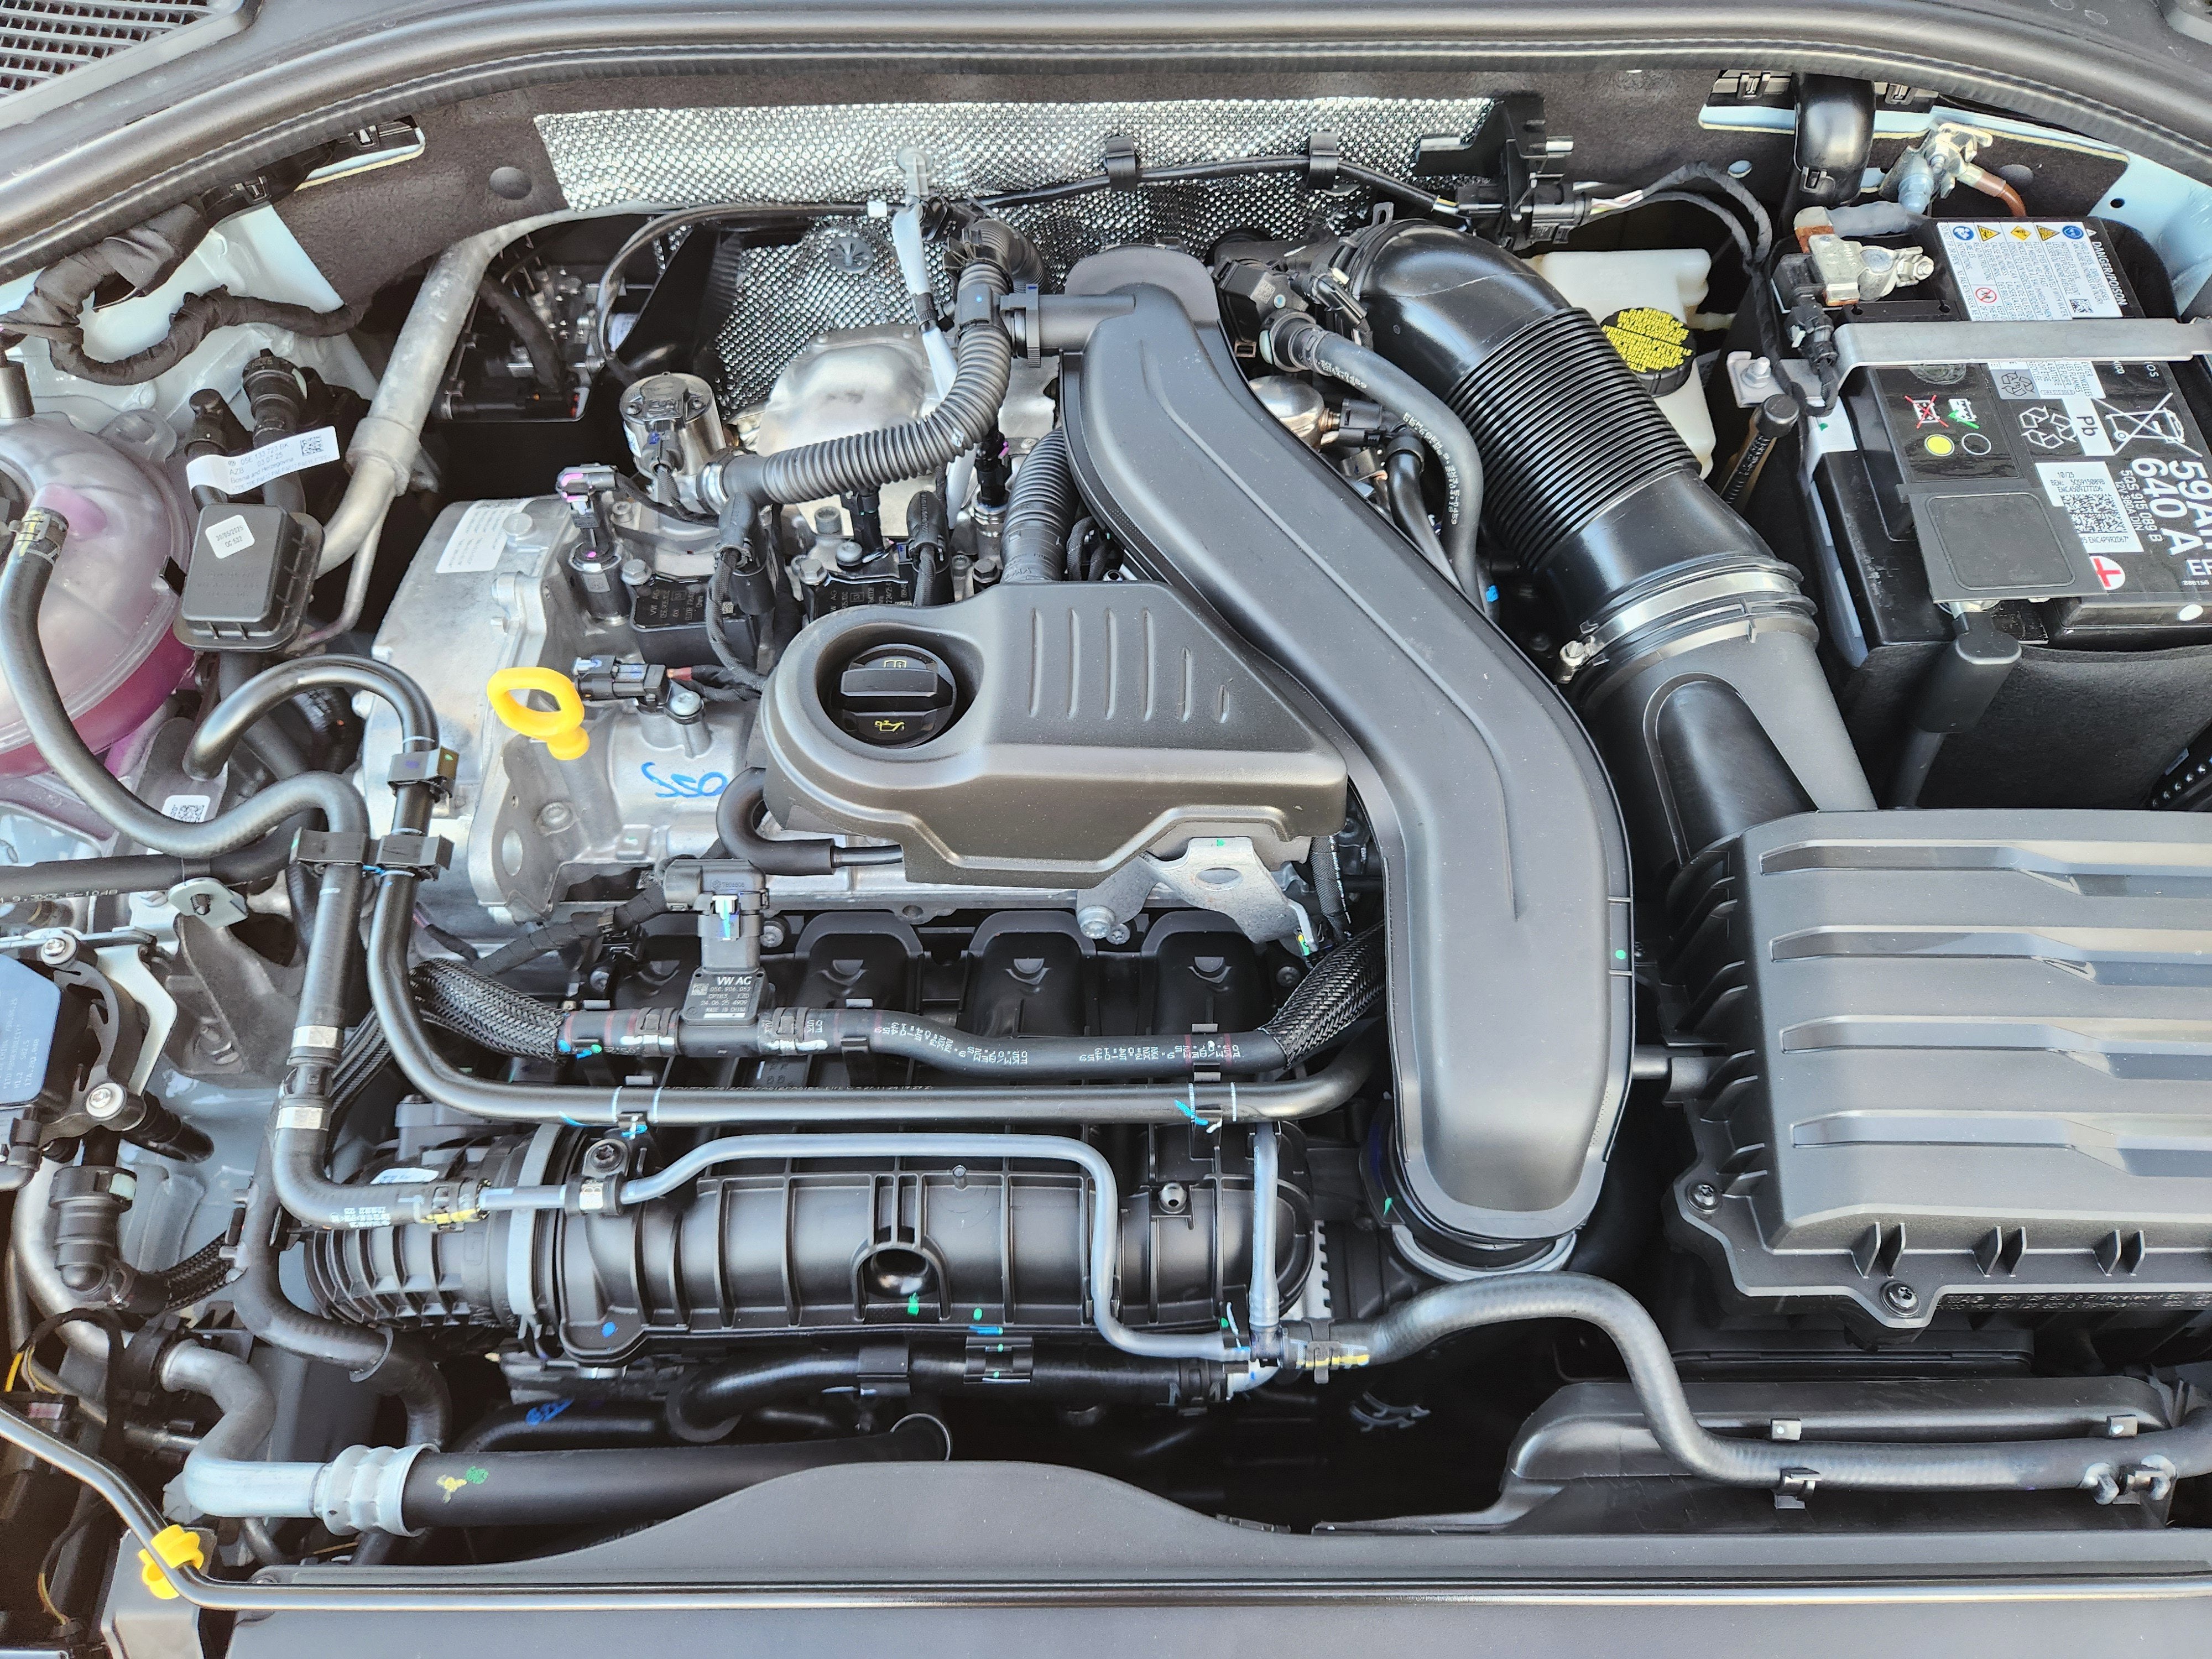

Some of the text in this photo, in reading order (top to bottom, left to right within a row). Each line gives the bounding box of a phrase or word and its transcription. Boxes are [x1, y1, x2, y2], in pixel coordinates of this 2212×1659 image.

[1970, 242, 1983, 253] READ
[2030, 241, 2043, 253] FLUSH
[2078, 241, 2090, 254] SHIELD
[1983, 248, 1997, 264] SEVERE
[1988, 242, 2010, 275] CAUSE BLINDNESS
[1996, 242, 2020, 278] SULFURIC ACID CAN
[2026, 249, 2040, 266] MEDICAL
[2033, 267, 2045, 277] HELP
[2036, 254, 2048, 263] EYES
[2073, 249, 2086, 262] CAUSE
[2023, 263, 2036, 273] YEUX
[2057, 257, 2073, 277] EXPLOSIFS
[2066, 278, 2081, 295] PEUVENT
[2079, 262, 2095, 283] BLINDNESS
[2092, 242, 2128, 306] DANGER/POISON
[2040, 264, 2059, 291] IMMEDIATELY
[2090, 268, 2105, 287] EXPLOSIVE
[2003, 281, 2017, 296] CAUSER
[2052, 291, 2064, 301] WITH
[1986, 305, 1997, 314] THE
[1995, 305, 2006, 316] KEEP
[2008, 311, 2020, 320] GRA
[2018, 297, 2036, 320] SULFURIQU
[2145, 361, 2161, 378] OS
[2076, 416, 2096, 436] Pb
[231, 474, 249, 483] Bosnia
[2115, 481, 2145, 531] 12V 380A DIN
[2120, 469, 2164, 542] 5QS 915 089 B
[2131, 457, 2188, 519] 640
[2161, 528, 2204, 556] A
[650, 604, 658, 615] VW
[717, 976, 752, 985] VW AG
